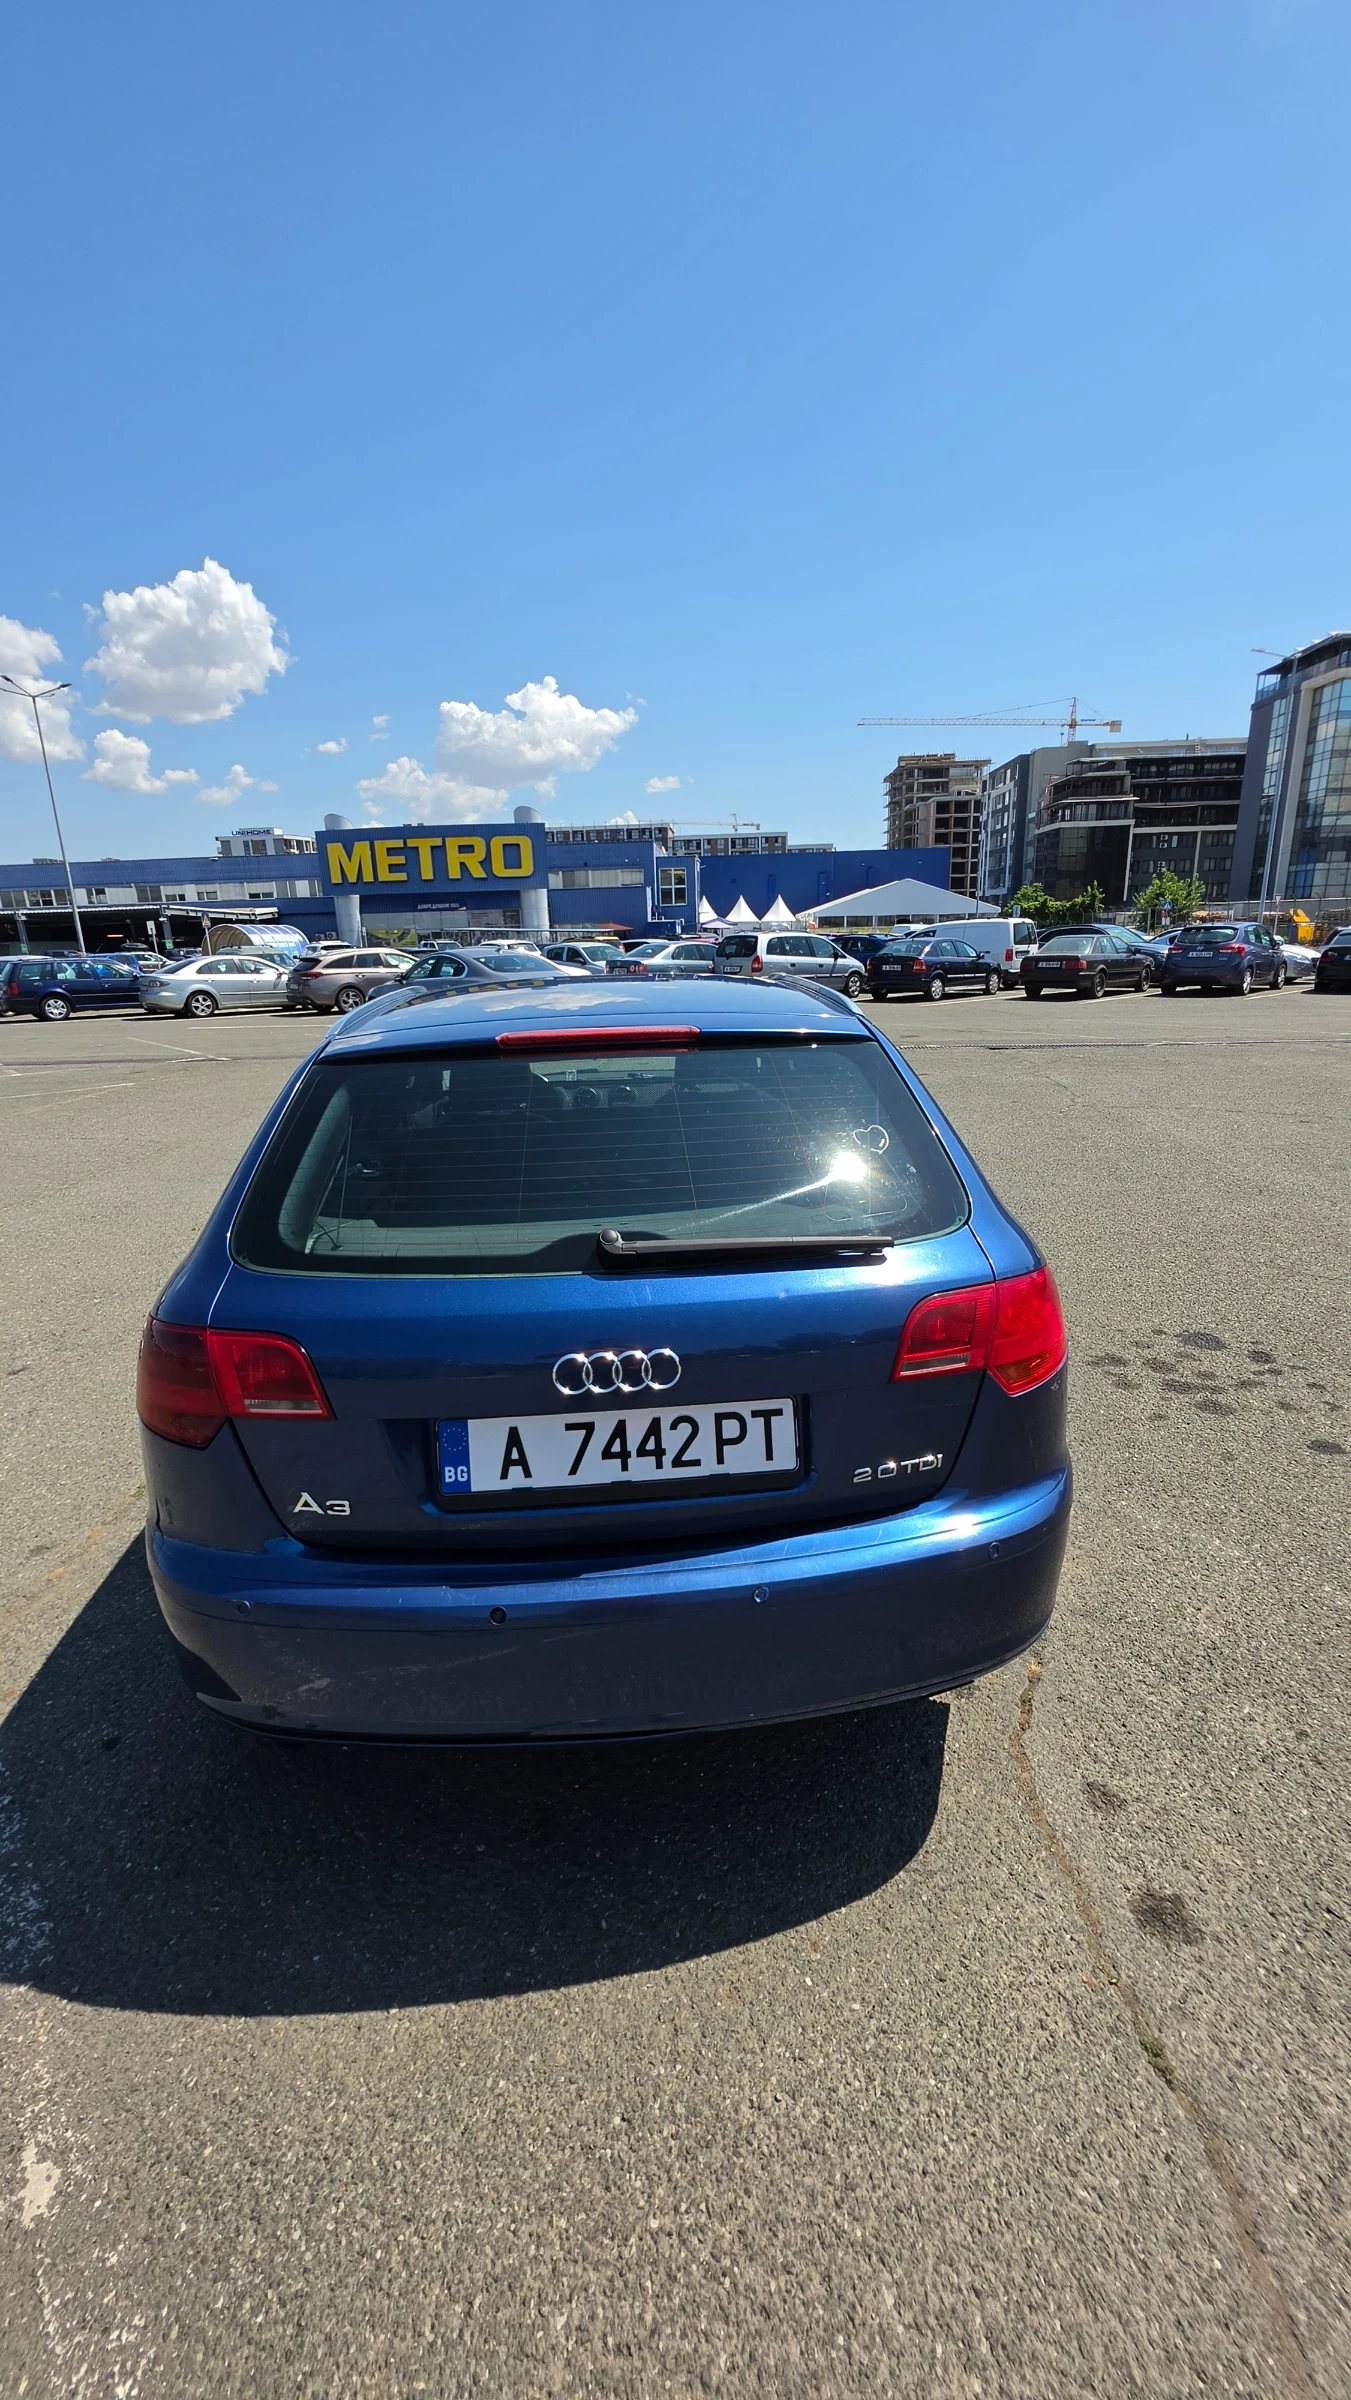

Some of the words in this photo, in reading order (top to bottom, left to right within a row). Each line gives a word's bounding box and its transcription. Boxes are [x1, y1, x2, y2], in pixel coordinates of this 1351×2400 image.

[326, 835, 534, 884] METRO
[499, 1426, 533, 1480] A
[900, 1453, 944, 1474] TDI
[444, 1461, 468, 1483] BG
[293, 1491, 351, 1516] A3
